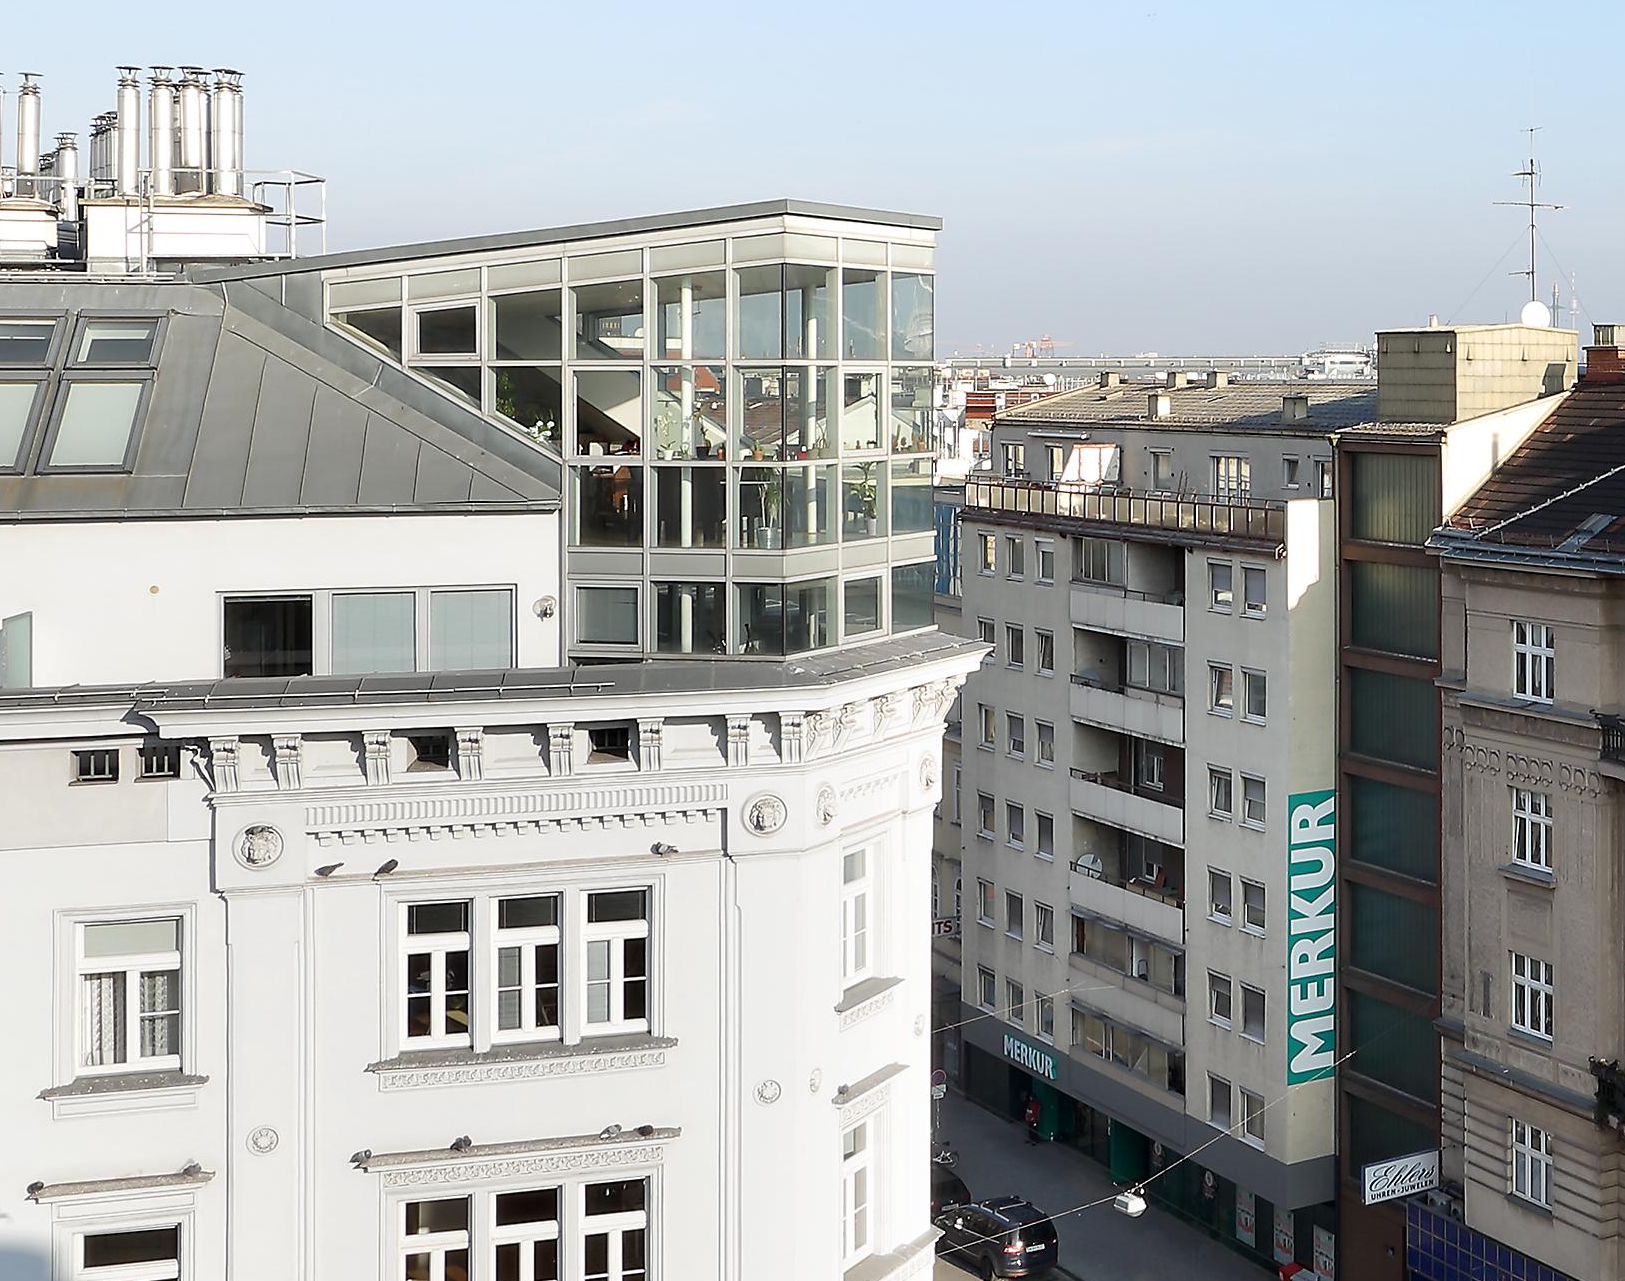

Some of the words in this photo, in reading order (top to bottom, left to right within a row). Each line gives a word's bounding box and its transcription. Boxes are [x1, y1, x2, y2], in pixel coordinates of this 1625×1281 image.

[1290, 796, 1335, 1074] MERKUR
[1003, 1034, 1057, 1080] MERKUR
[1369, 1162, 1435, 1192] Ehlers
